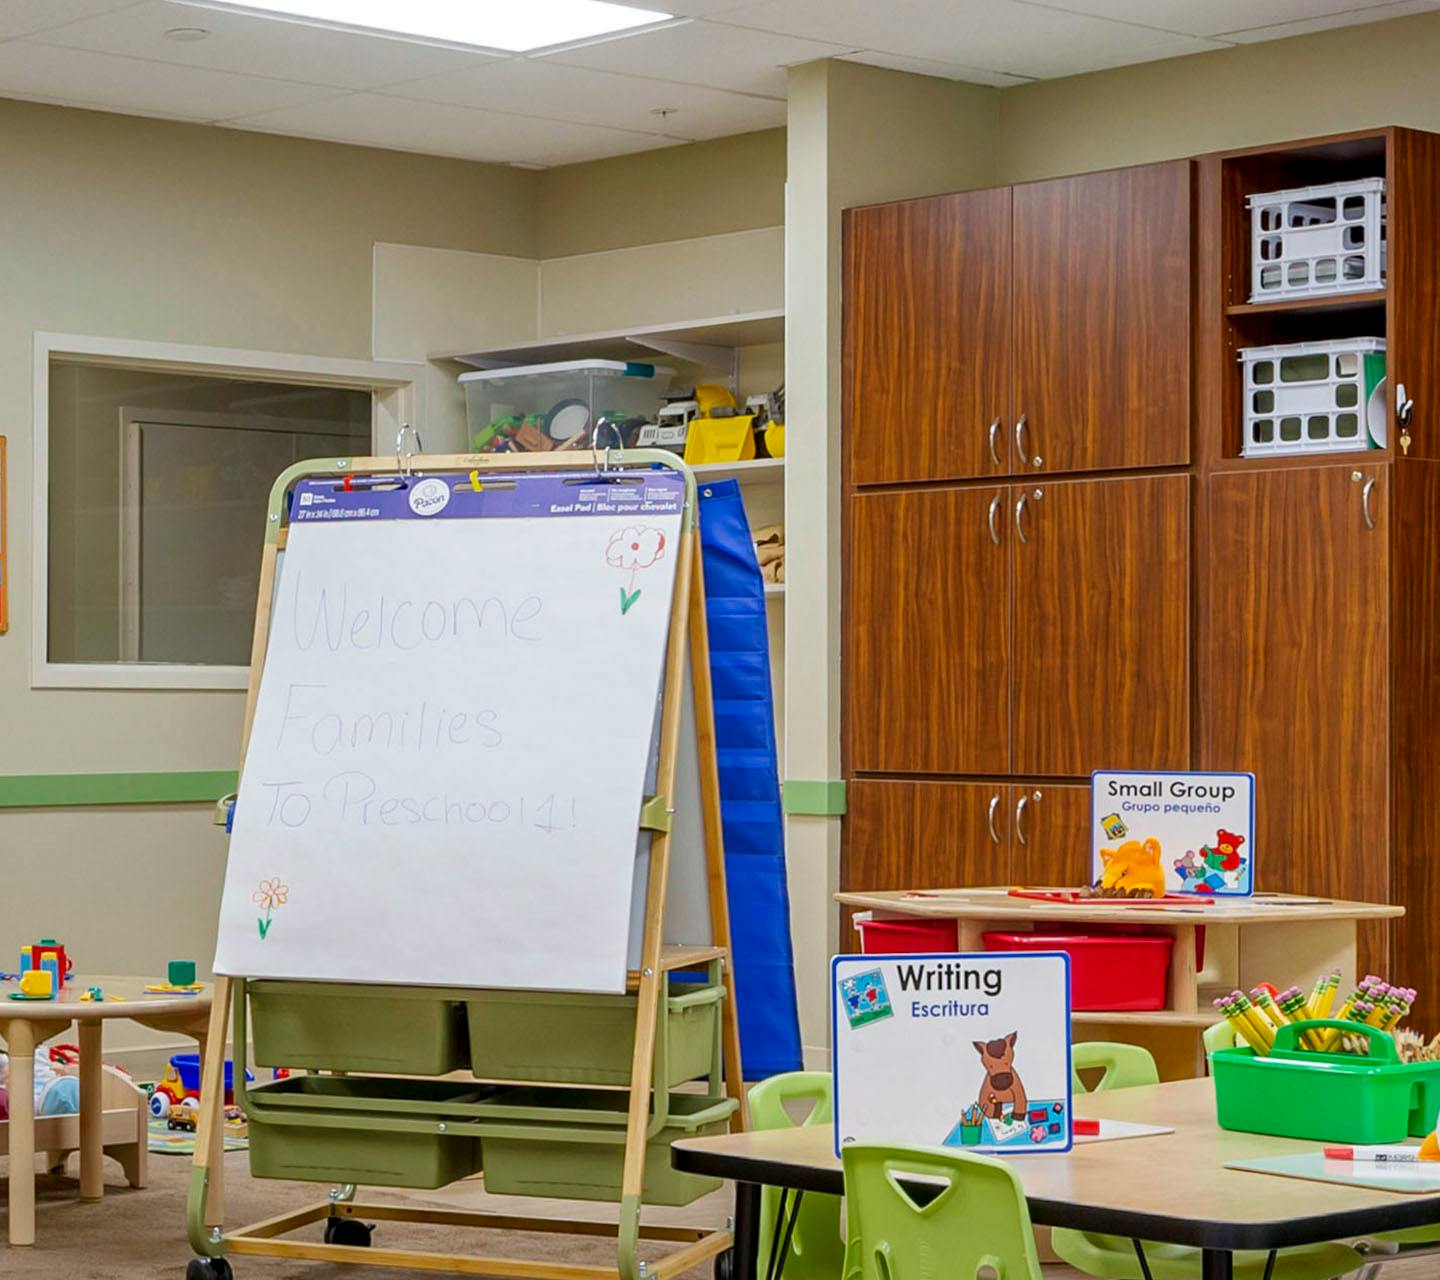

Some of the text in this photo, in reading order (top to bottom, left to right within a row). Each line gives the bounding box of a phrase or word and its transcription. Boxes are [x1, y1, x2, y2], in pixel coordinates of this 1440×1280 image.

[574, 503, 592, 513] Pad
[596, 503, 616, 512] Bloc
[617, 504, 639, 513] pour
[293, 569, 544, 652] Welcome
[276, 683, 503, 756] Families
[262, 780, 312, 828] To
[1108, 780, 1236, 803] Small Group
[1121, 801, 1222, 815] Grupo pequeño
[896, 963, 1002, 996] Writing
[911, 1000, 989, 1017] Escritura
